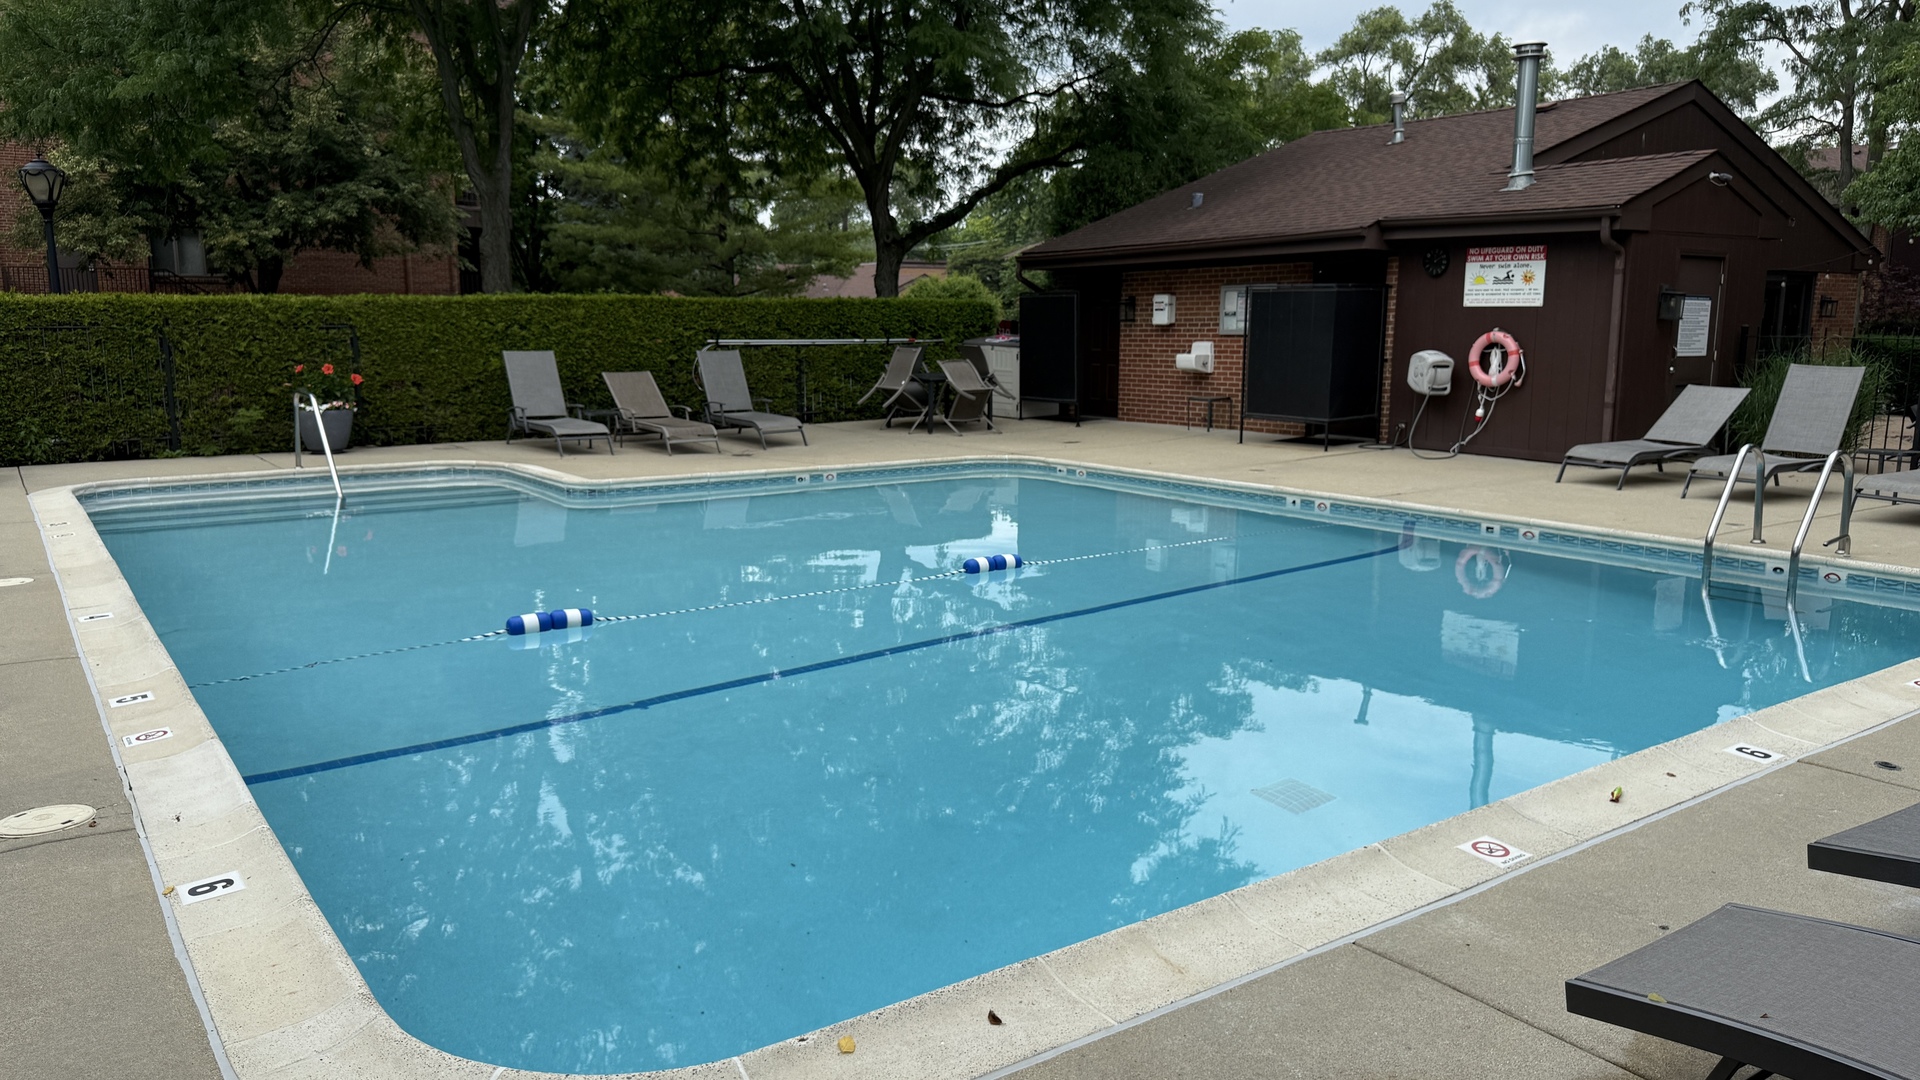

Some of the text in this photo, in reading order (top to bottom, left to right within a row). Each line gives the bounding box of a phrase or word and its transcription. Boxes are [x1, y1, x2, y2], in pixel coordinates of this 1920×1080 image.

[1480, 246, 1514, 254] LIFEGUARD
[1515, 245, 1526, 253] ON
[1527, 245, 1544, 253] DUTY
[115, 693, 149, 704] 5
[1735, 746, 1772, 759] 6
[187, 878, 235, 897] 6
